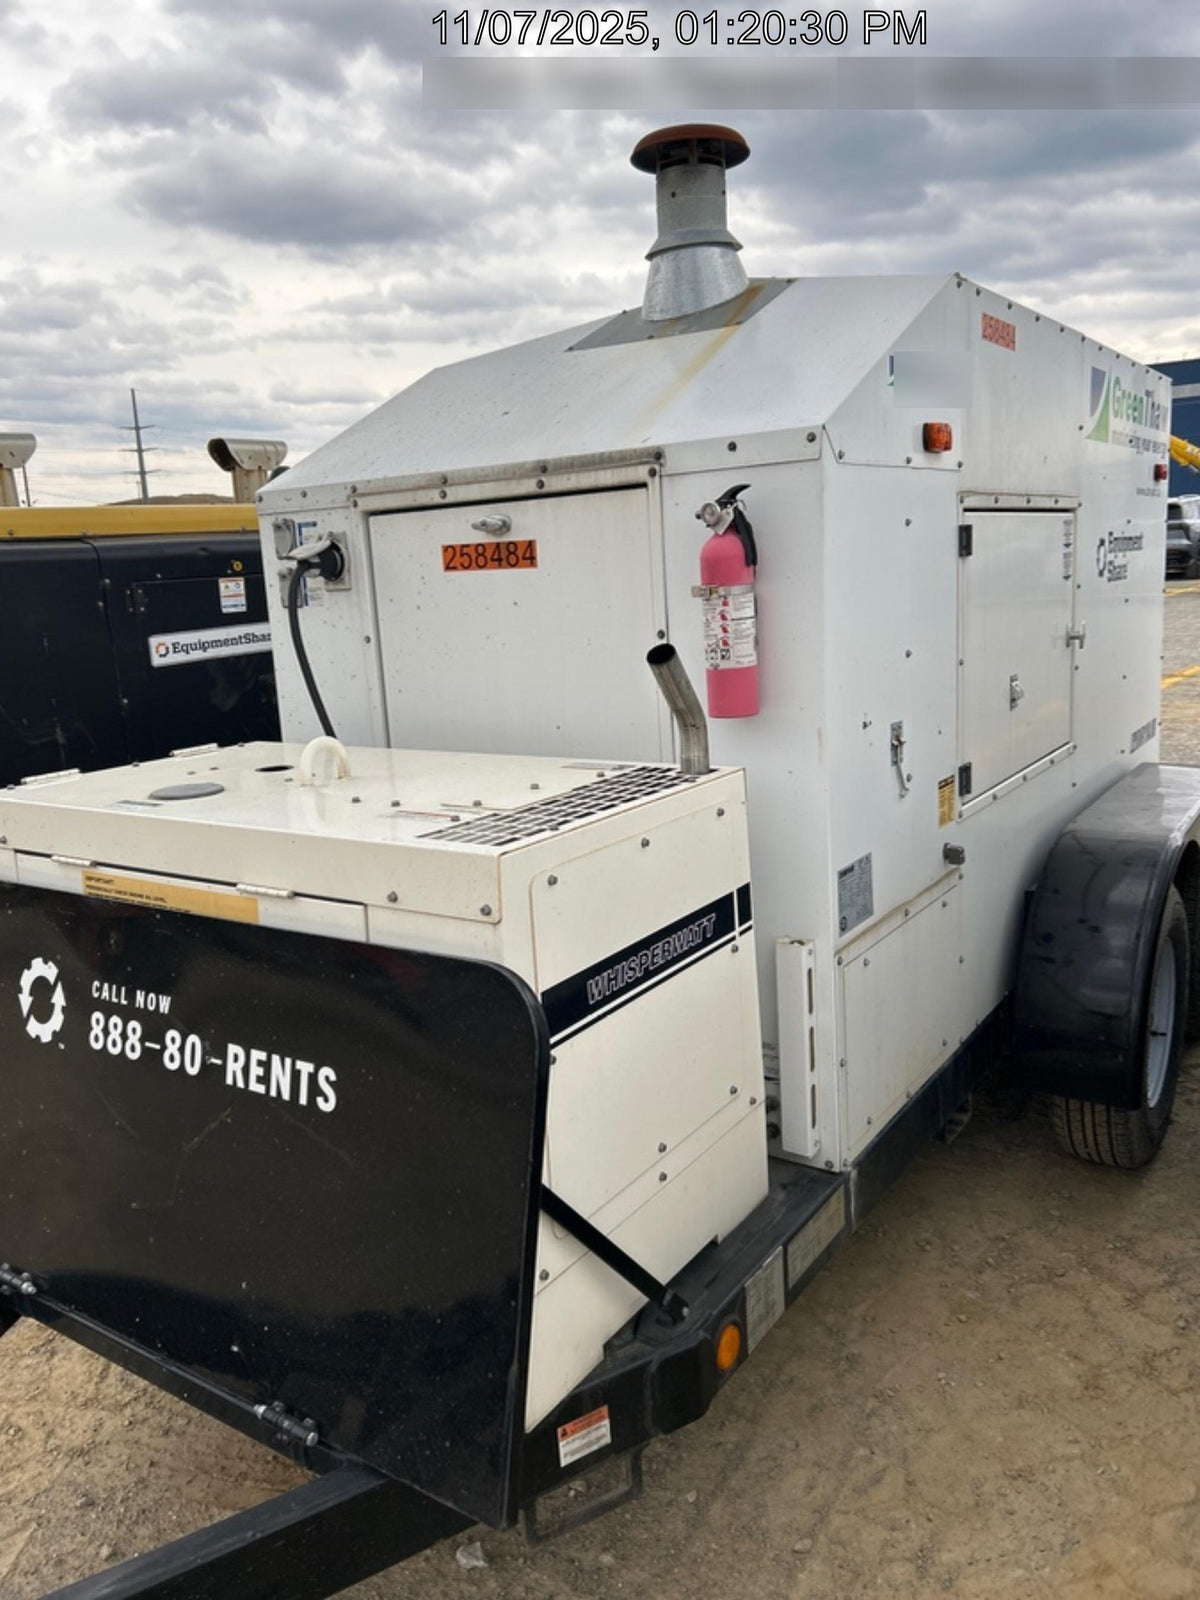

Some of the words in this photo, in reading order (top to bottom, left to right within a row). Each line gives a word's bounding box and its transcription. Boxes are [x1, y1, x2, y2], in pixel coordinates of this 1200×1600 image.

[443, 540, 536, 570] 258484
[171, 632, 272, 655] EquipmentShar
[586, 913, 717, 1005] WHISPERWATT
[92, 980, 128, 1006] CALL
[135, 989, 171, 1014] NOW
[89, 1010, 337, 1113] 888-80-RENTS
